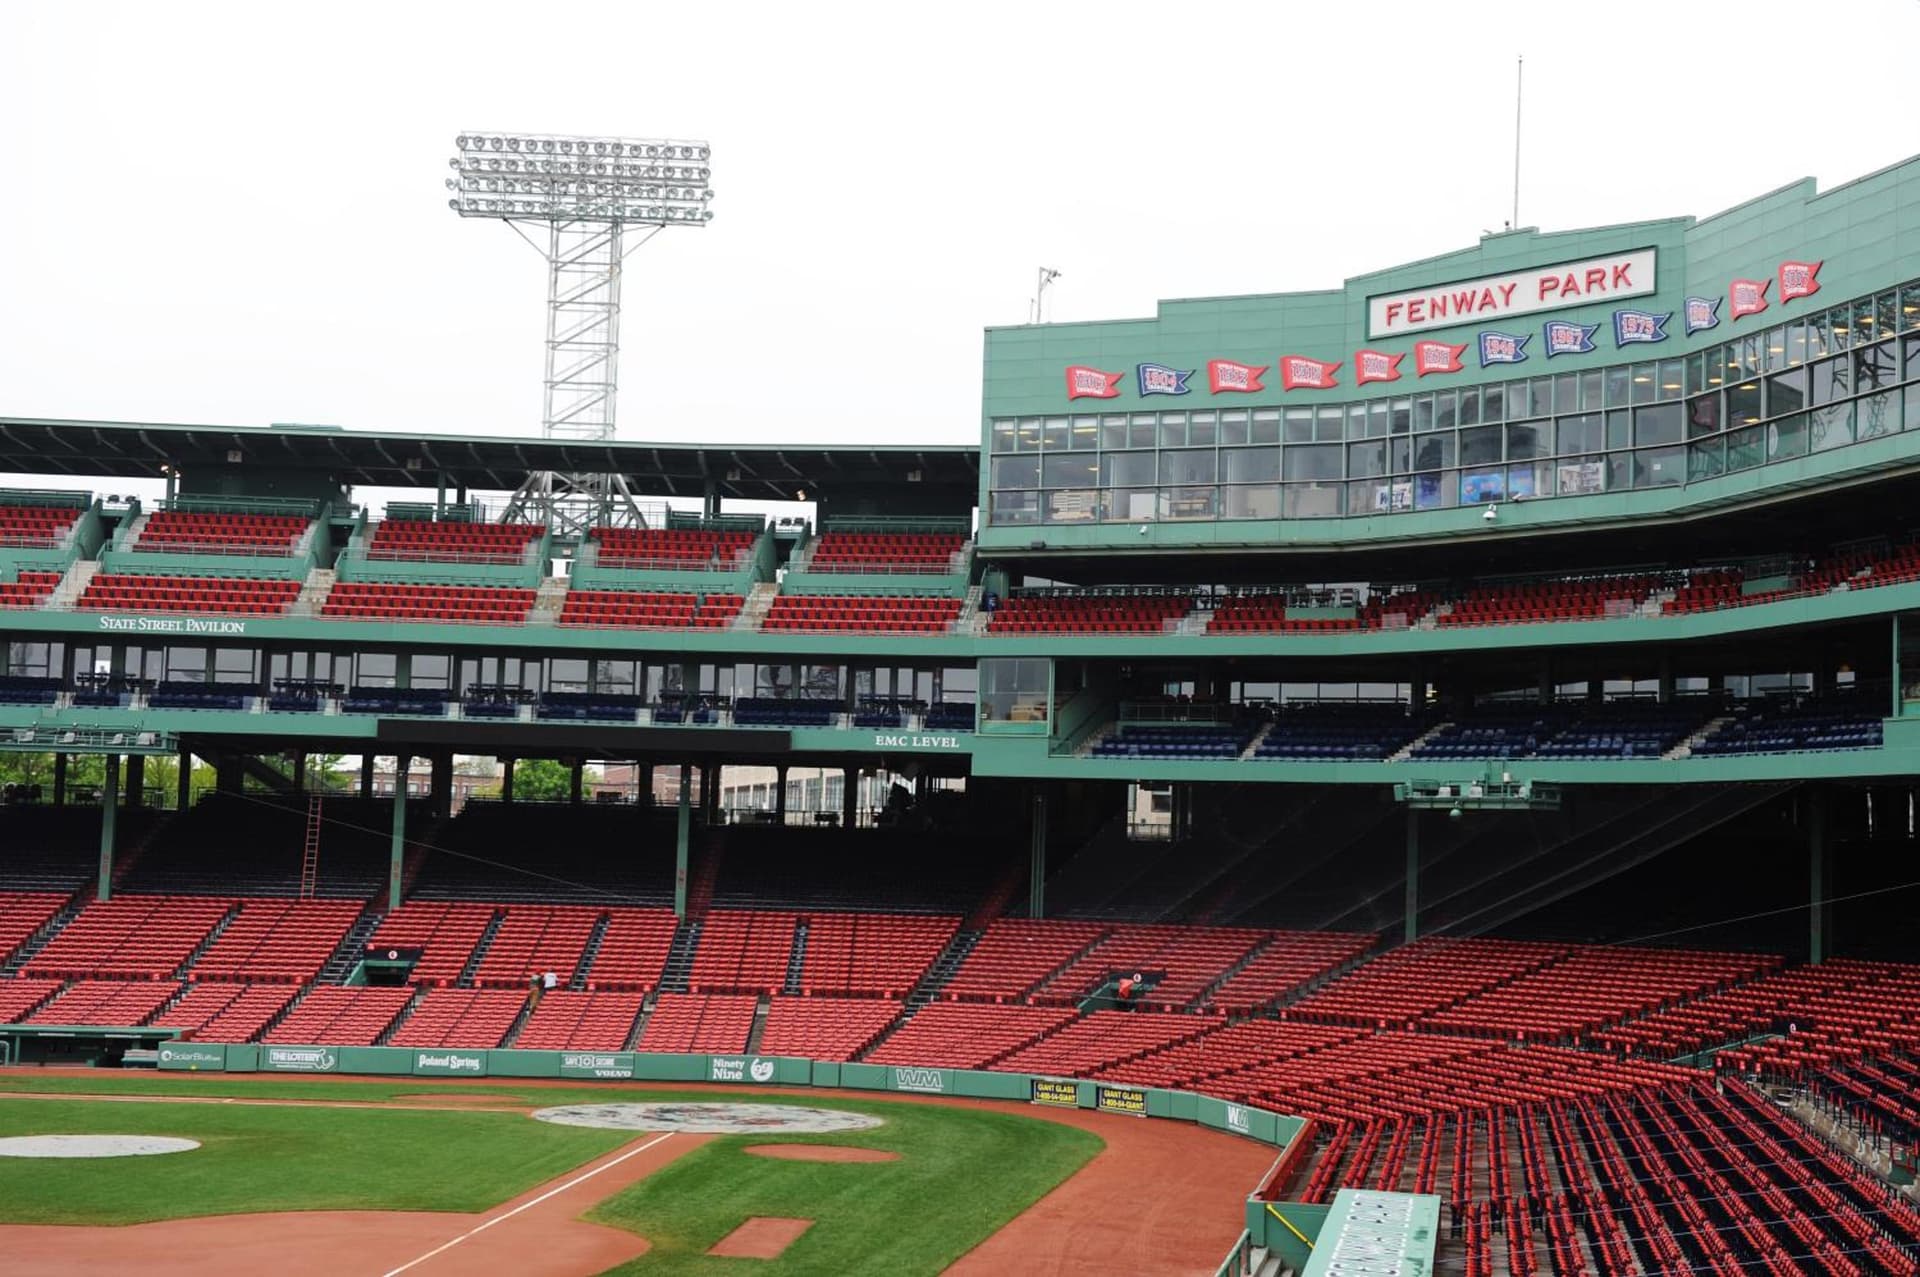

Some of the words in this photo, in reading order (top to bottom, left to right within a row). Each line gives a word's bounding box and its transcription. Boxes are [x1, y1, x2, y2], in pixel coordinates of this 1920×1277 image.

[1385, 282, 1517, 327] FENWAY
[1538, 262, 1633, 302] PARK
[1622, 316, 1655, 335] 1975
[1551, 328, 1583, 346] 1967
[100, 616, 136, 630] STATE
[186, 618, 245, 633] PAVILION
[875, 735, 908, 746] EMC
[912, 736, 960, 748] LEVEL
[272, 1051, 288, 1061] THE
[288, 1052, 321, 1062] LOTTERY
[418, 1054, 449, 1068] Poland
[450, 1055, 480, 1071] Spring
[712, 1058, 746, 1070] Ninety
[594, 1069, 632, 1078] VOLVO
[712, 1068, 743, 1080] Nine
[896, 1068, 942, 1088] WM
[1037, 1083, 1055, 1092] GIANT
[1055, 1084, 1075, 1094] GLASS
[1103, 1089, 1121, 1099] GIANT
[1121, 1091, 1143, 1102] GLASS
